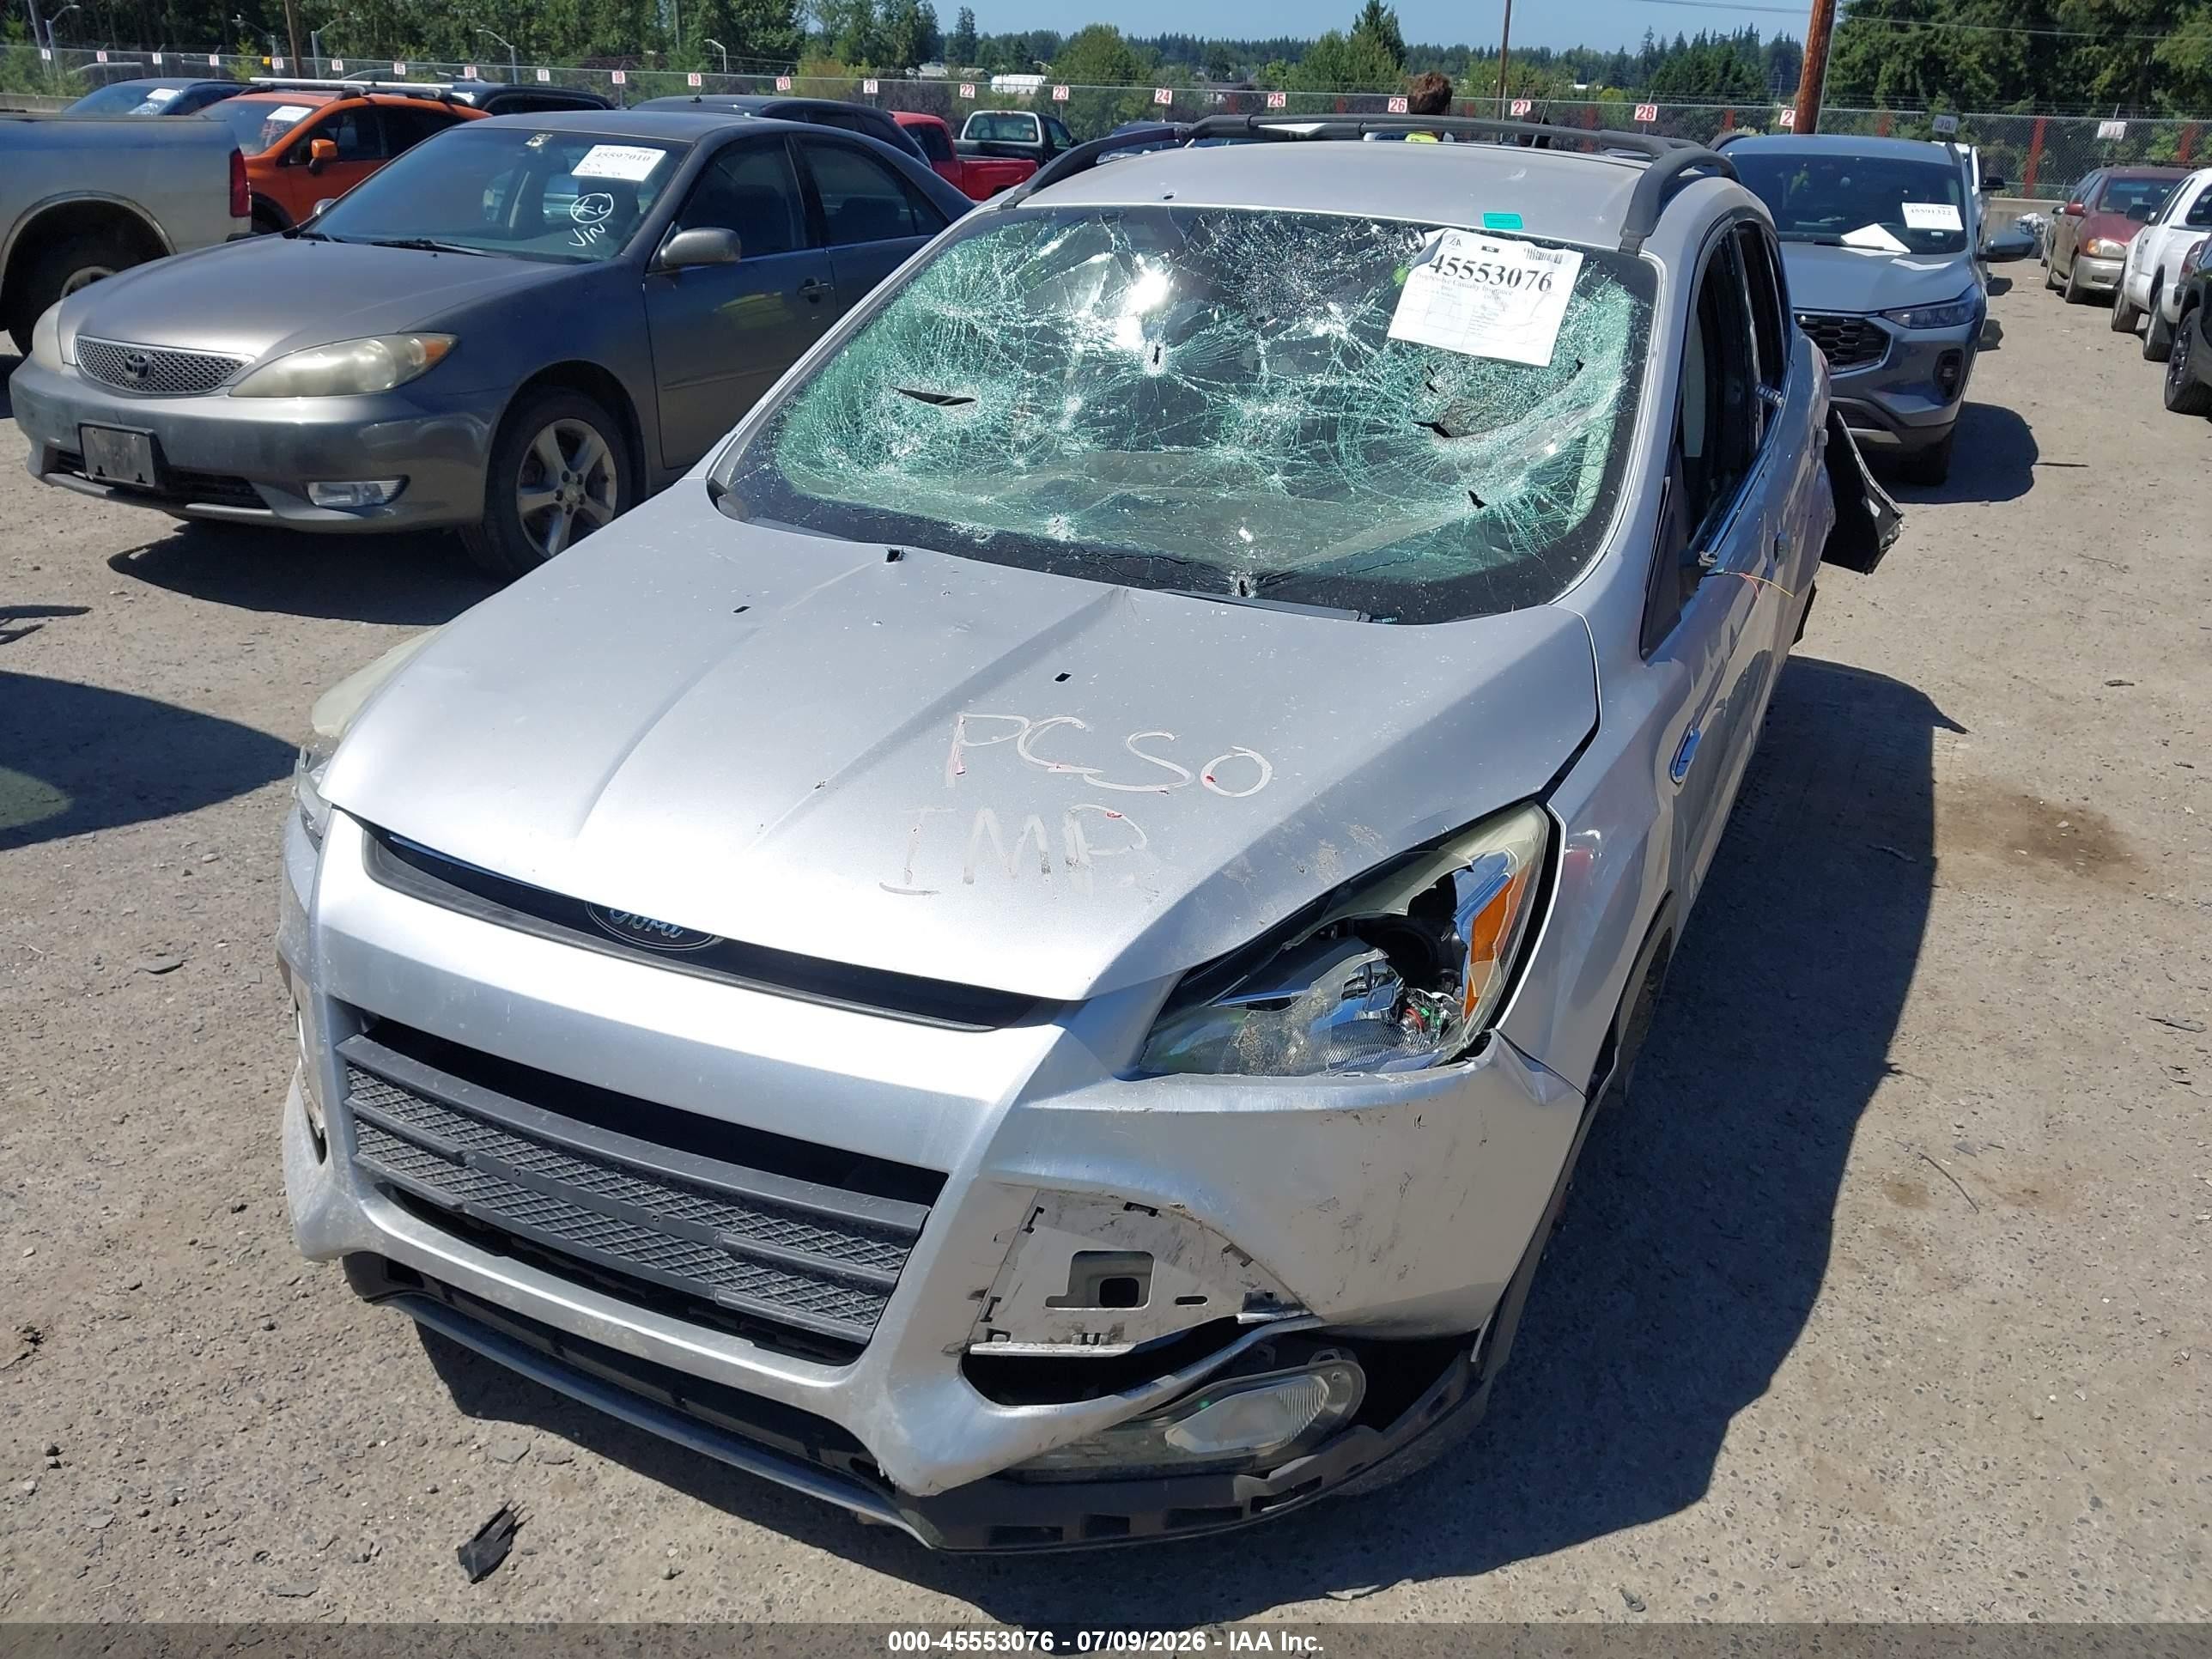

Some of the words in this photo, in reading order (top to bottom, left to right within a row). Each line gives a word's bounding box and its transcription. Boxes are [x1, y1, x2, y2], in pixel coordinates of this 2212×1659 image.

[614, 71, 624, 82] 18
[690, 74, 700, 85] 19
[777, 77, 789, 89] 20
[866, 81, 876, 92] 21
[962, 84, 973, 97] 22
[1054, 87, 1067, 99] 23
[1156, 90, 1170, 103] 24
[1269, 94, 1284, 106] 25
[1389, 98, 1405, 112] 26
[1513, 100, 1528, 115] 27
[1638, 106, 1655, 121] 28
[568, 223, 605, 246] VIN
[1429, 253, 1553, 293] 45553076
[944, 713, 1273, 798] PCSO
